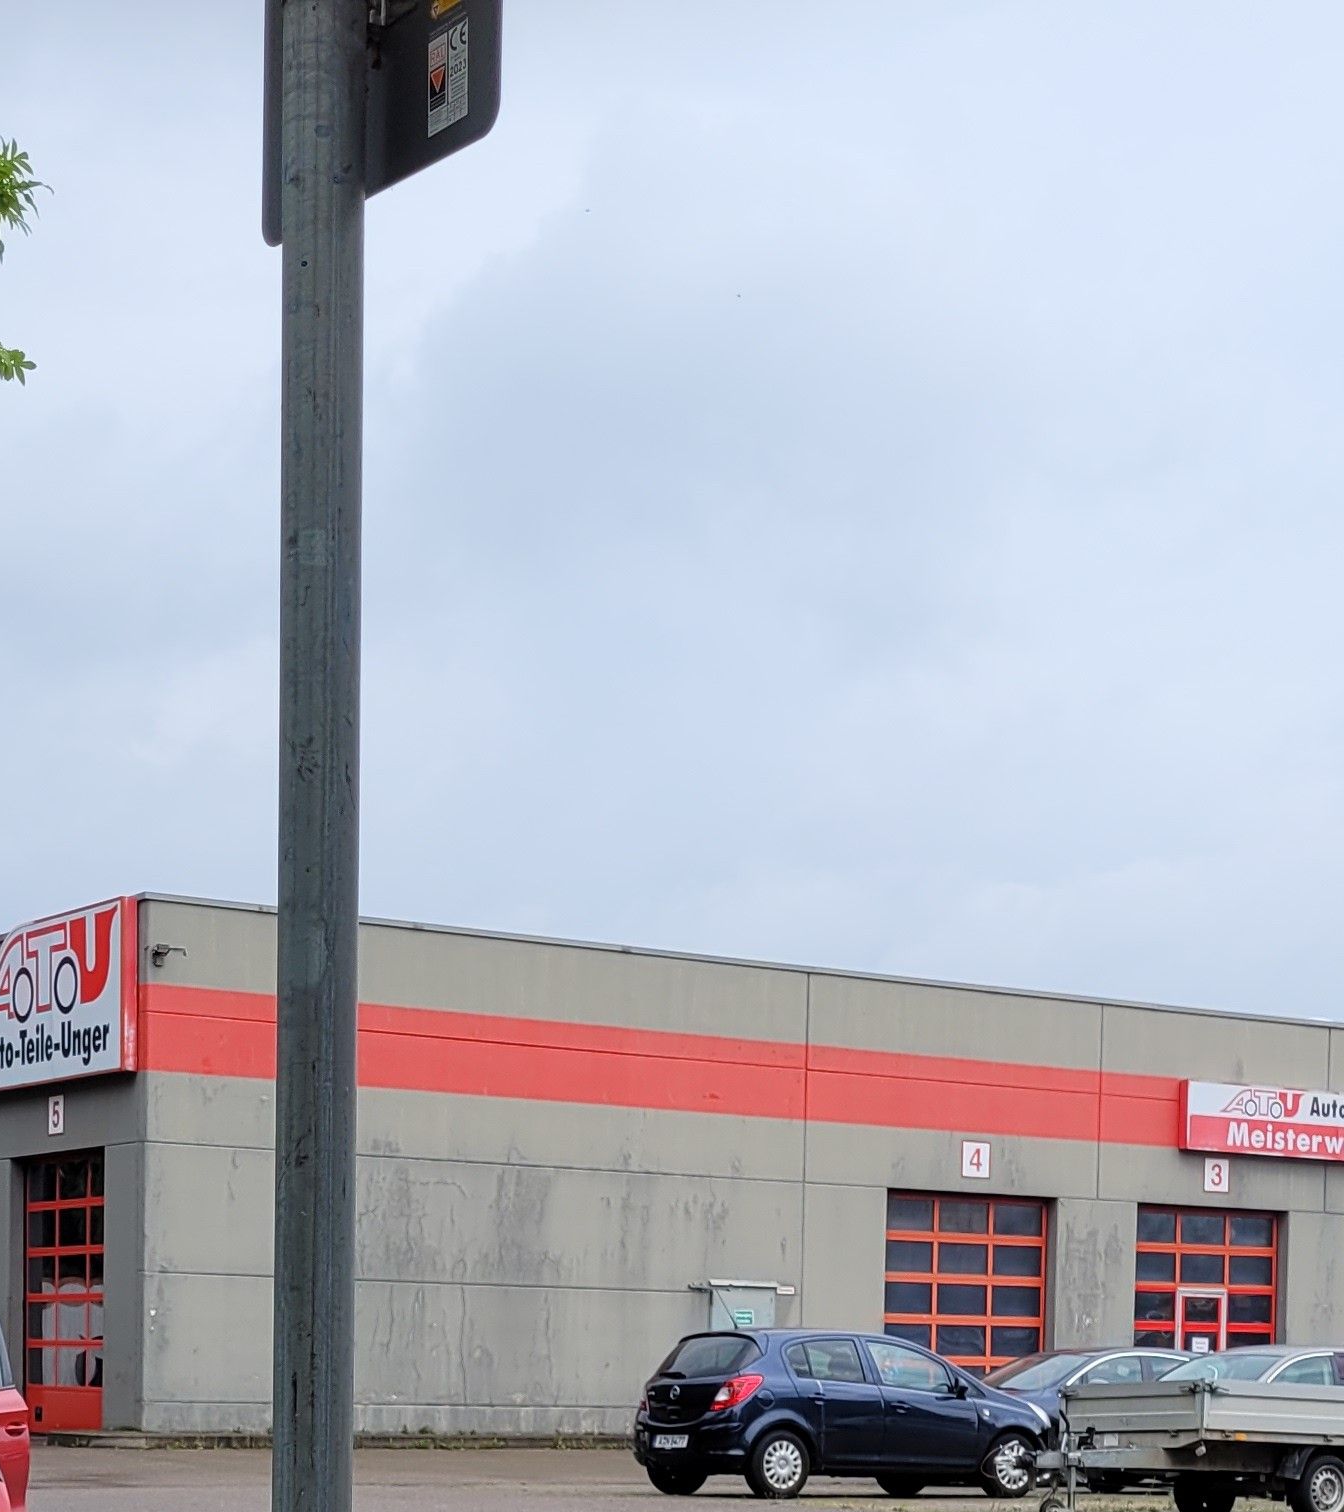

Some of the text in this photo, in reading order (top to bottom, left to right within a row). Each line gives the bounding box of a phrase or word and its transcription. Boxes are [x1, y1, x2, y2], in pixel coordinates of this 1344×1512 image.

[50, 1100, 61, 1128] 5
[967, 1147, 984, 1174] 4
[1210, 1165, 1224, 1188] 3
